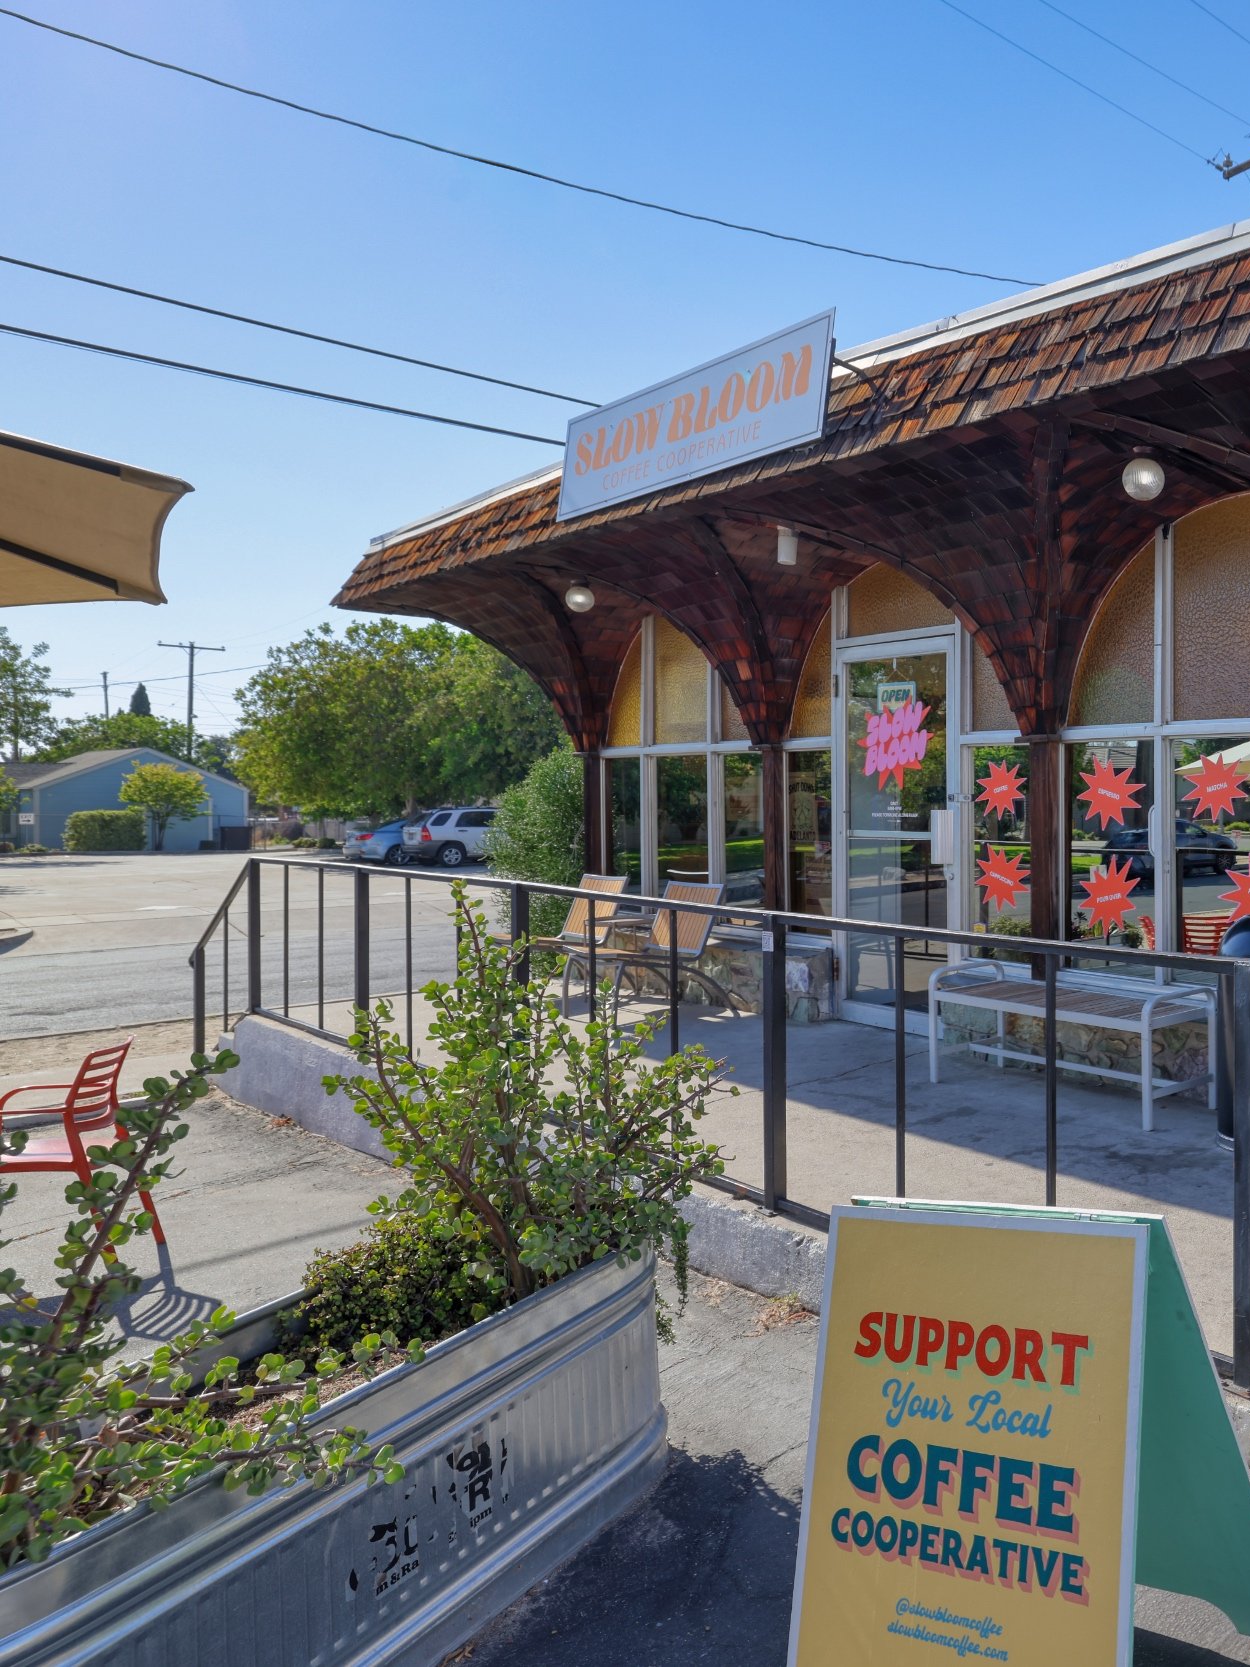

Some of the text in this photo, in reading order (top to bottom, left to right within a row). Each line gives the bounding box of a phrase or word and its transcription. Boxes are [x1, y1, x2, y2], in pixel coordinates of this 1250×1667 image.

[574, 344, 813, 477] SLOW BLOOM
[602, 420, 762, 490] COFFEE COOPERATIVE
[881, 689, 910, 702] OPEN
[866, 701, 923, 747] SLOW
[865, 729, 927, 776] BLOOM
[1206, 782, 1228, 793] MATCHA
[853, 1311, 1093, 1391] SUPPORT
[882, 1378, 1053, 1439] Your Local
[847, 1434, 1078, 1540] COFFEE
[831, 1507, 1088, 1602] COOPERATIVE
[887, 1620, 1009, 1662] slowbloomcoffee.com
[895, 1597, 1003, 1639] @slowbloomcoffee
